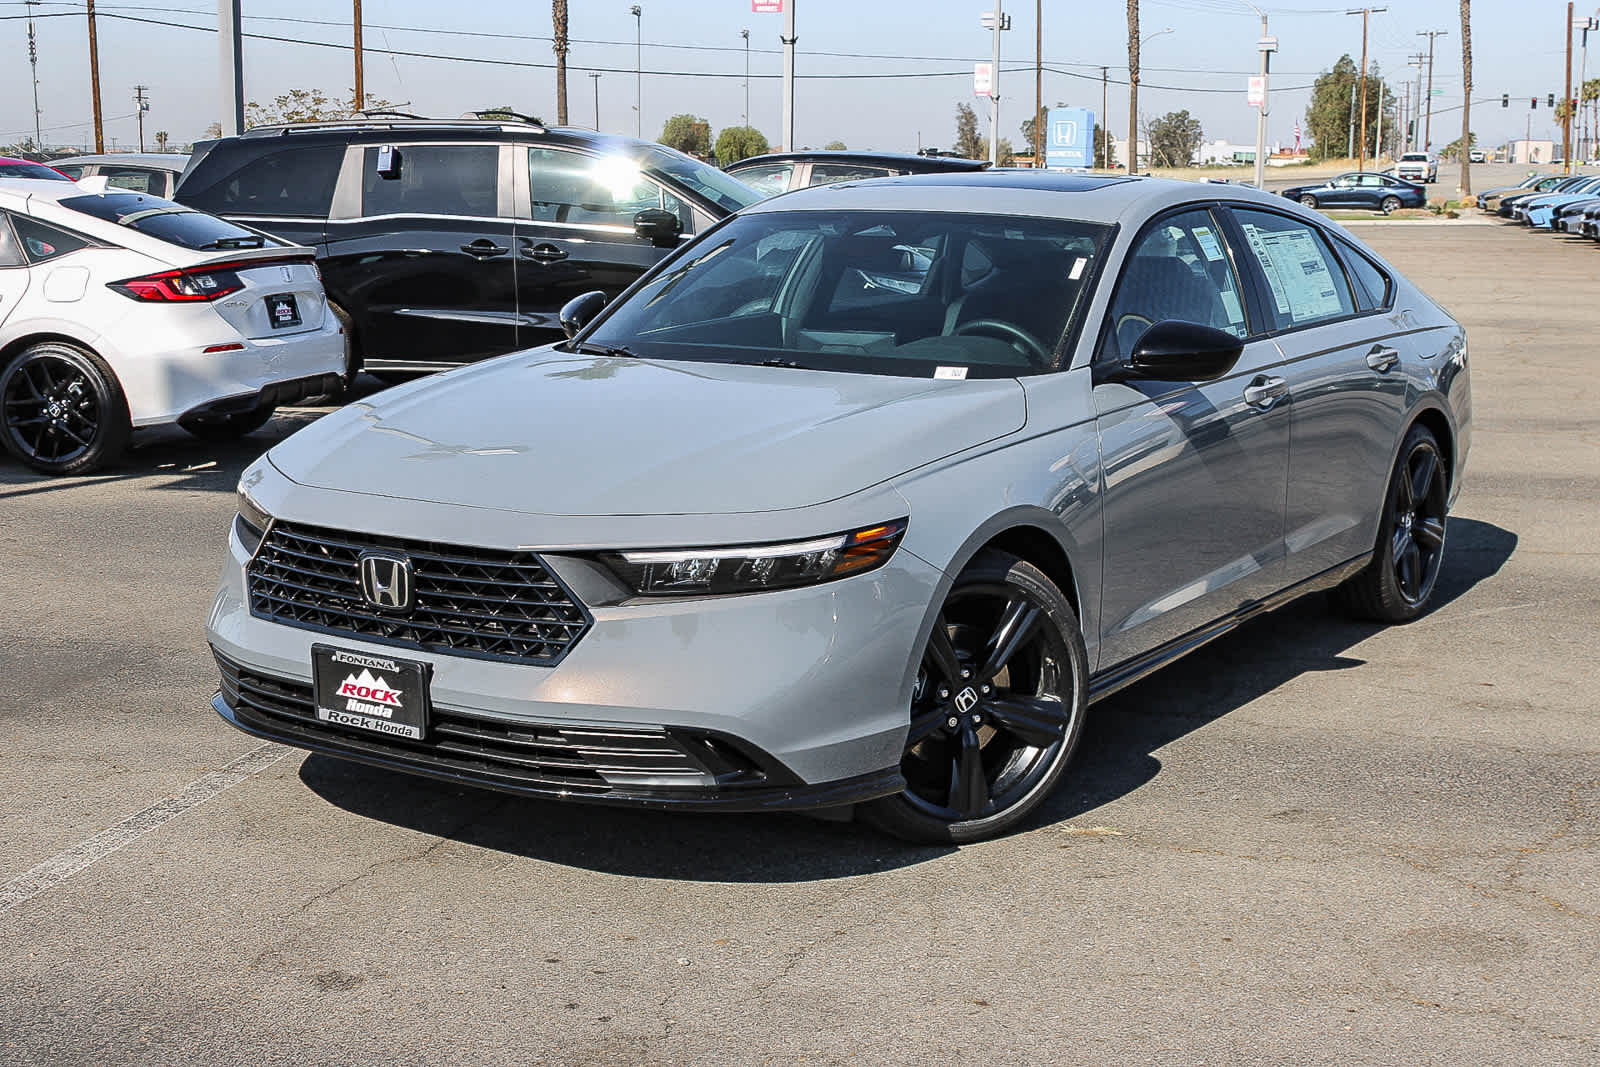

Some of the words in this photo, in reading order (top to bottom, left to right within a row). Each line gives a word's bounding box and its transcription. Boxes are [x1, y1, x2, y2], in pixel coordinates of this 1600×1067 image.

[340, 654, 393, 669] FONTANA
[342, 683, 398, 704] ROCK
[345, 698, 393, 719] Honda
[328, 711, 372, 729] Rock
[374, 720, 413, 737] Honda
